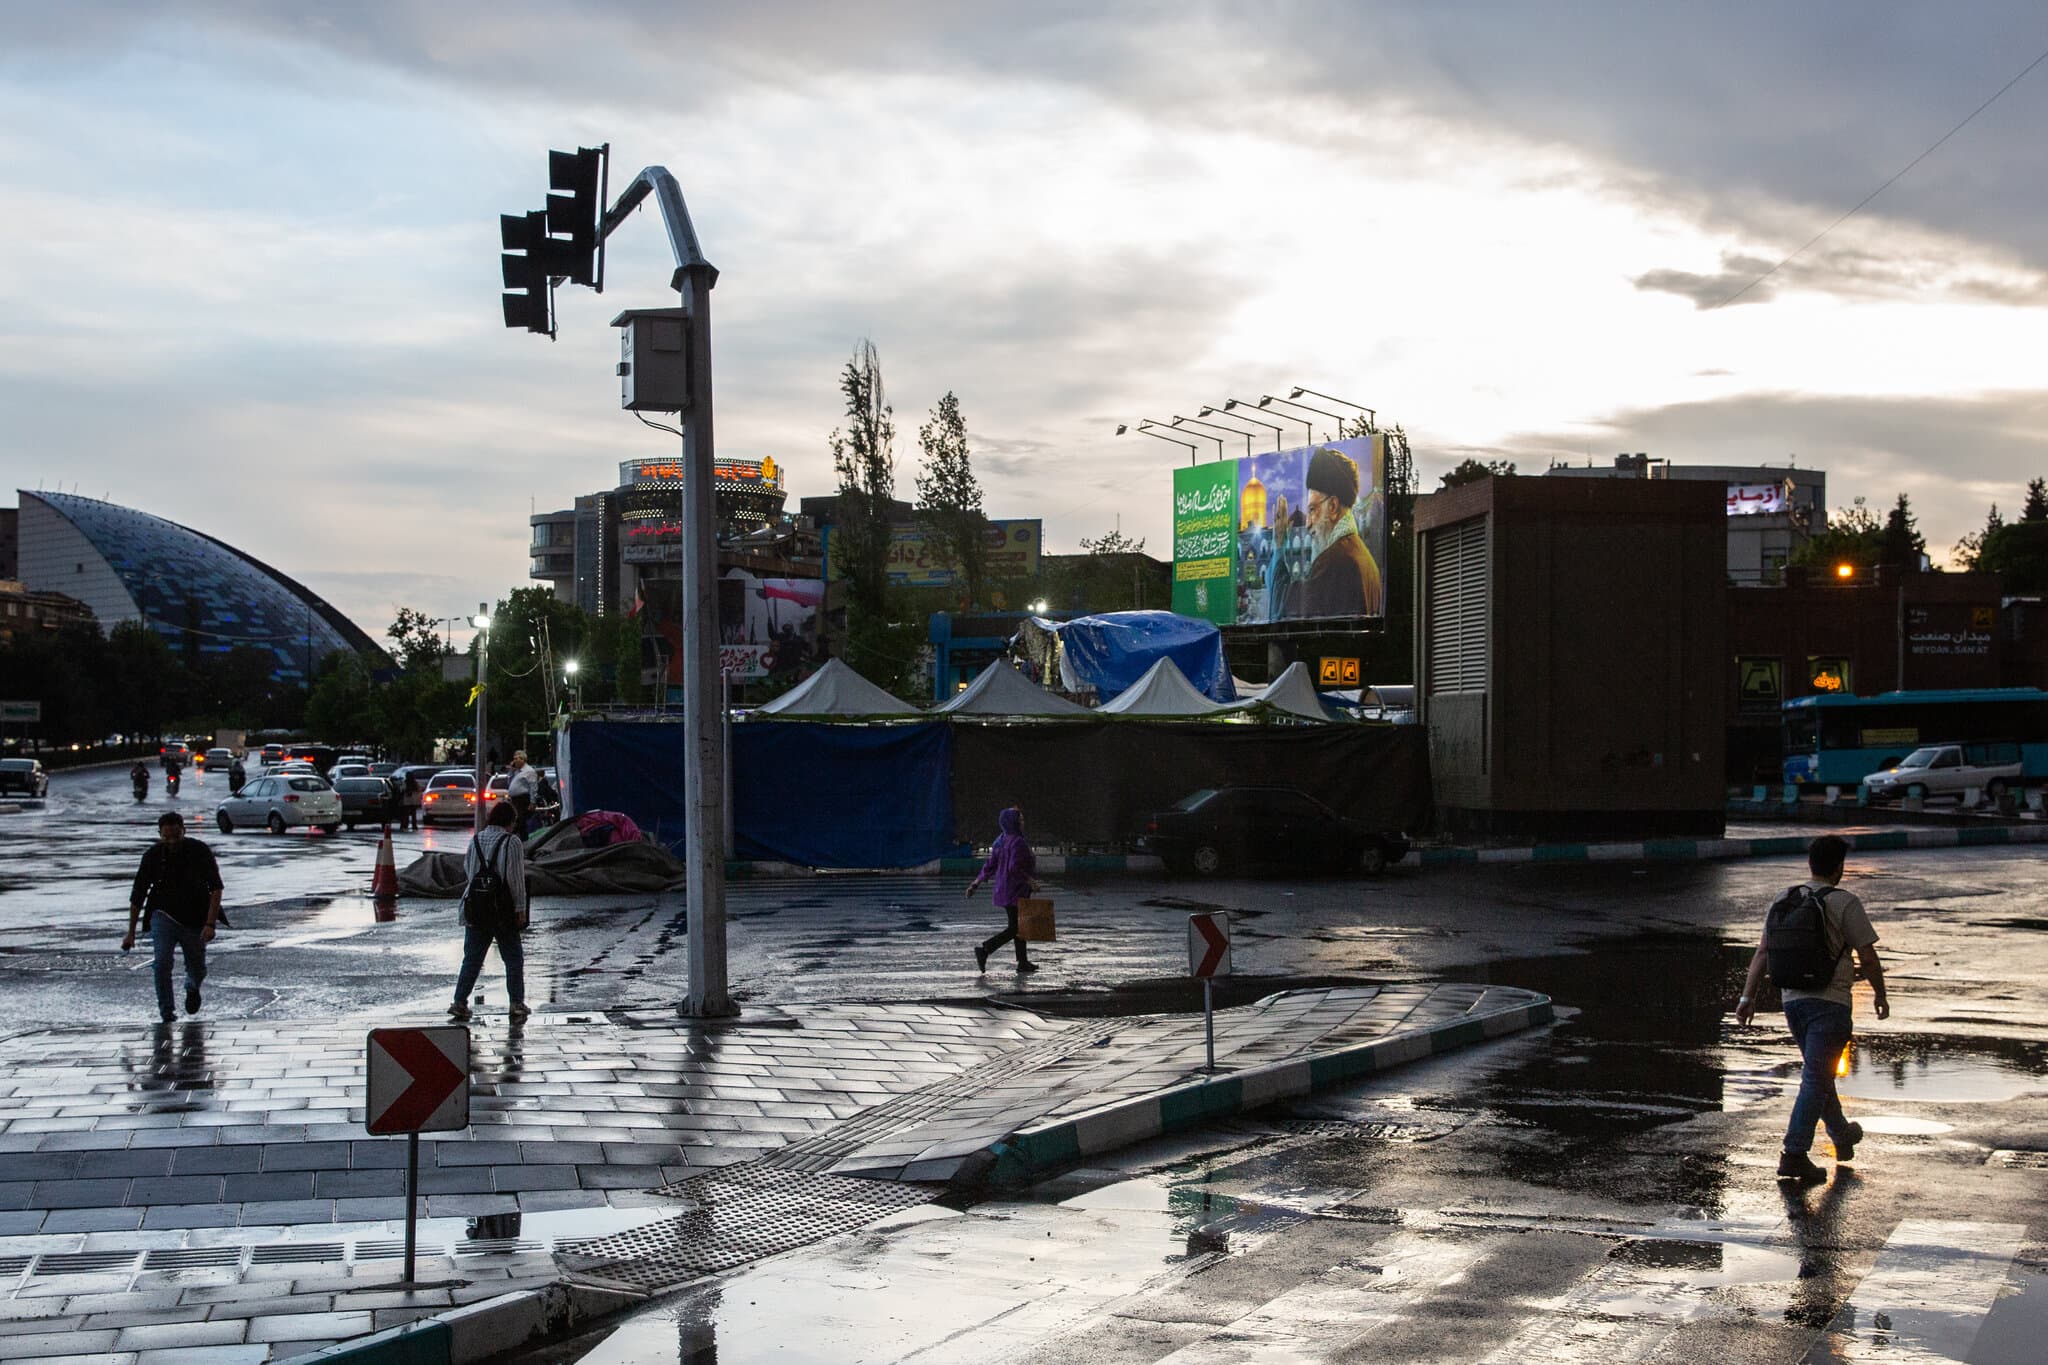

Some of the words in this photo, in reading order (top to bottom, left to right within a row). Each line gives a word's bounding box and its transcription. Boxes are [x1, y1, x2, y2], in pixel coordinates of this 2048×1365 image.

[1727, 482, 1781, 506] آزمای
[1909, 630, 1951, 641] صنعت
[1951, 628, 1991, 644] میدان
